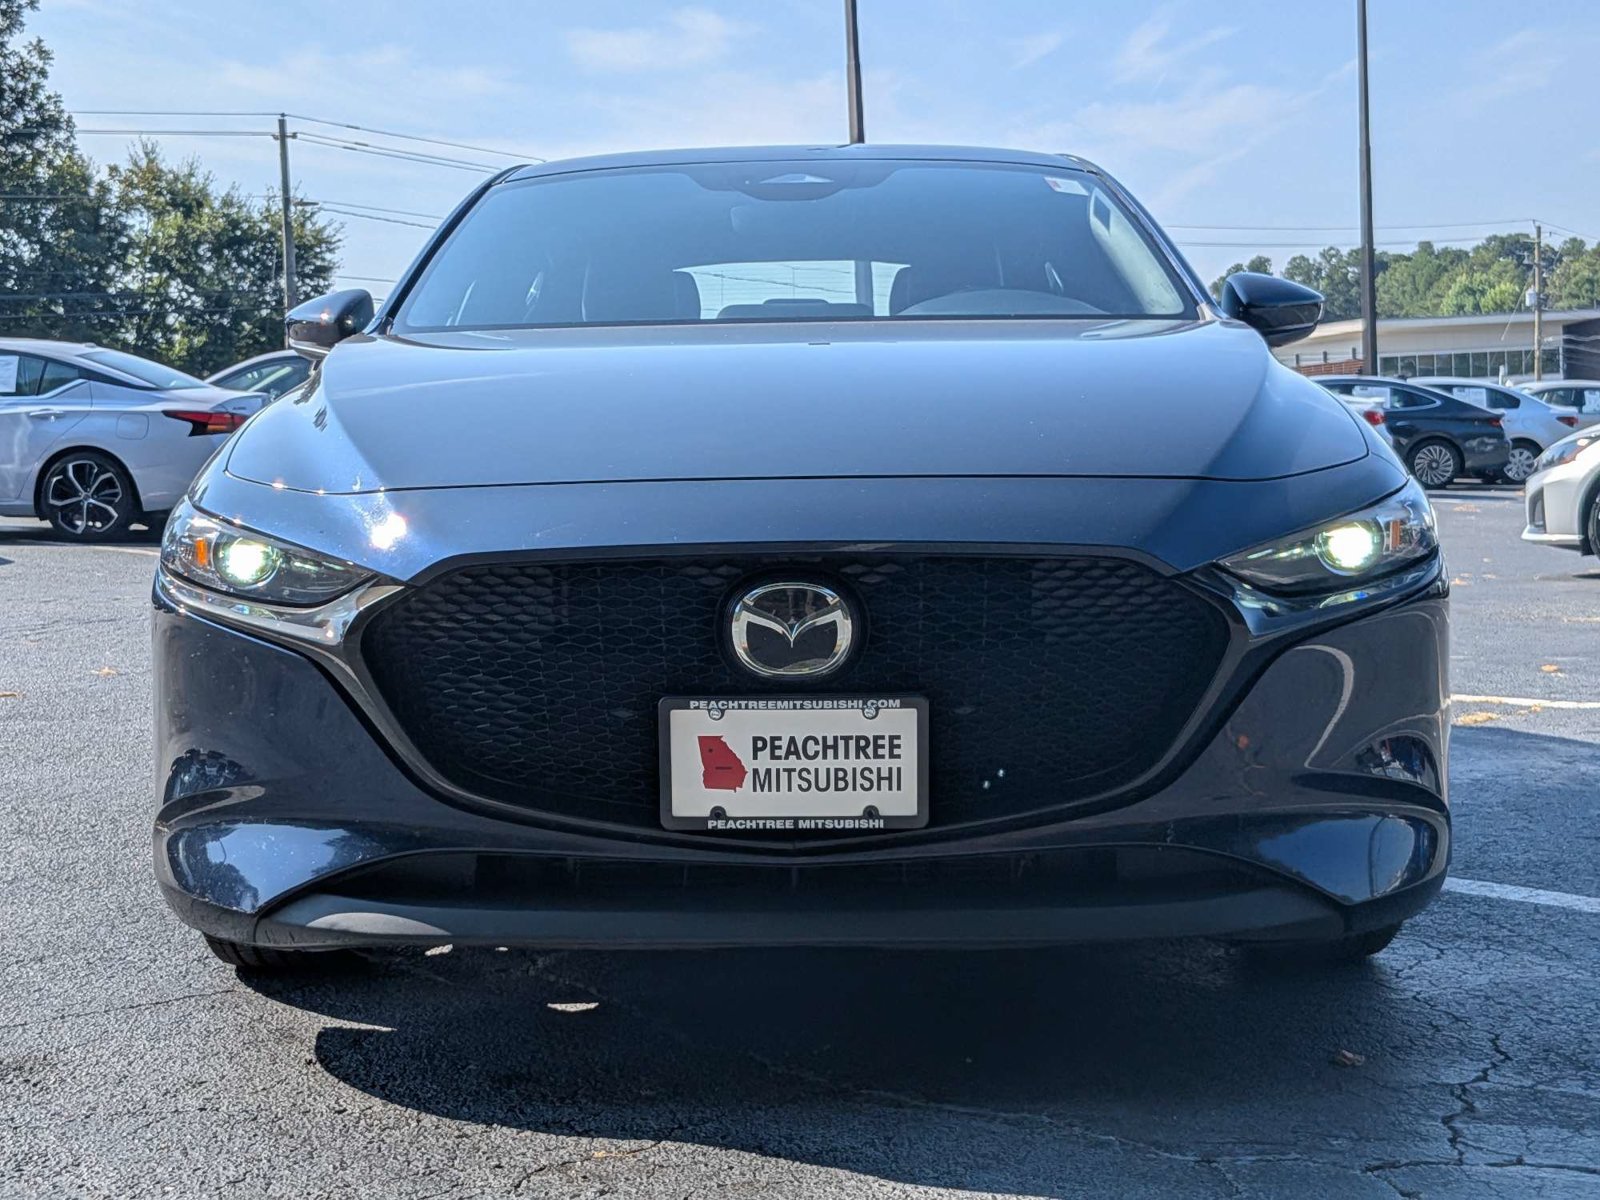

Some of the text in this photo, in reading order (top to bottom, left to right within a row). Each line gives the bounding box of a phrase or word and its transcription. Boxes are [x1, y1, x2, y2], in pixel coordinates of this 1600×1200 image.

[690, 699, 901, 710] PEACHTREEMITSUBISHI.COM
[752, 735, 902, 760] PEACHTREE
[752, 766, 902, 792] MITSUBISHI
[707, 818, 884, 830] PEACHTREE MITSUBISHI
